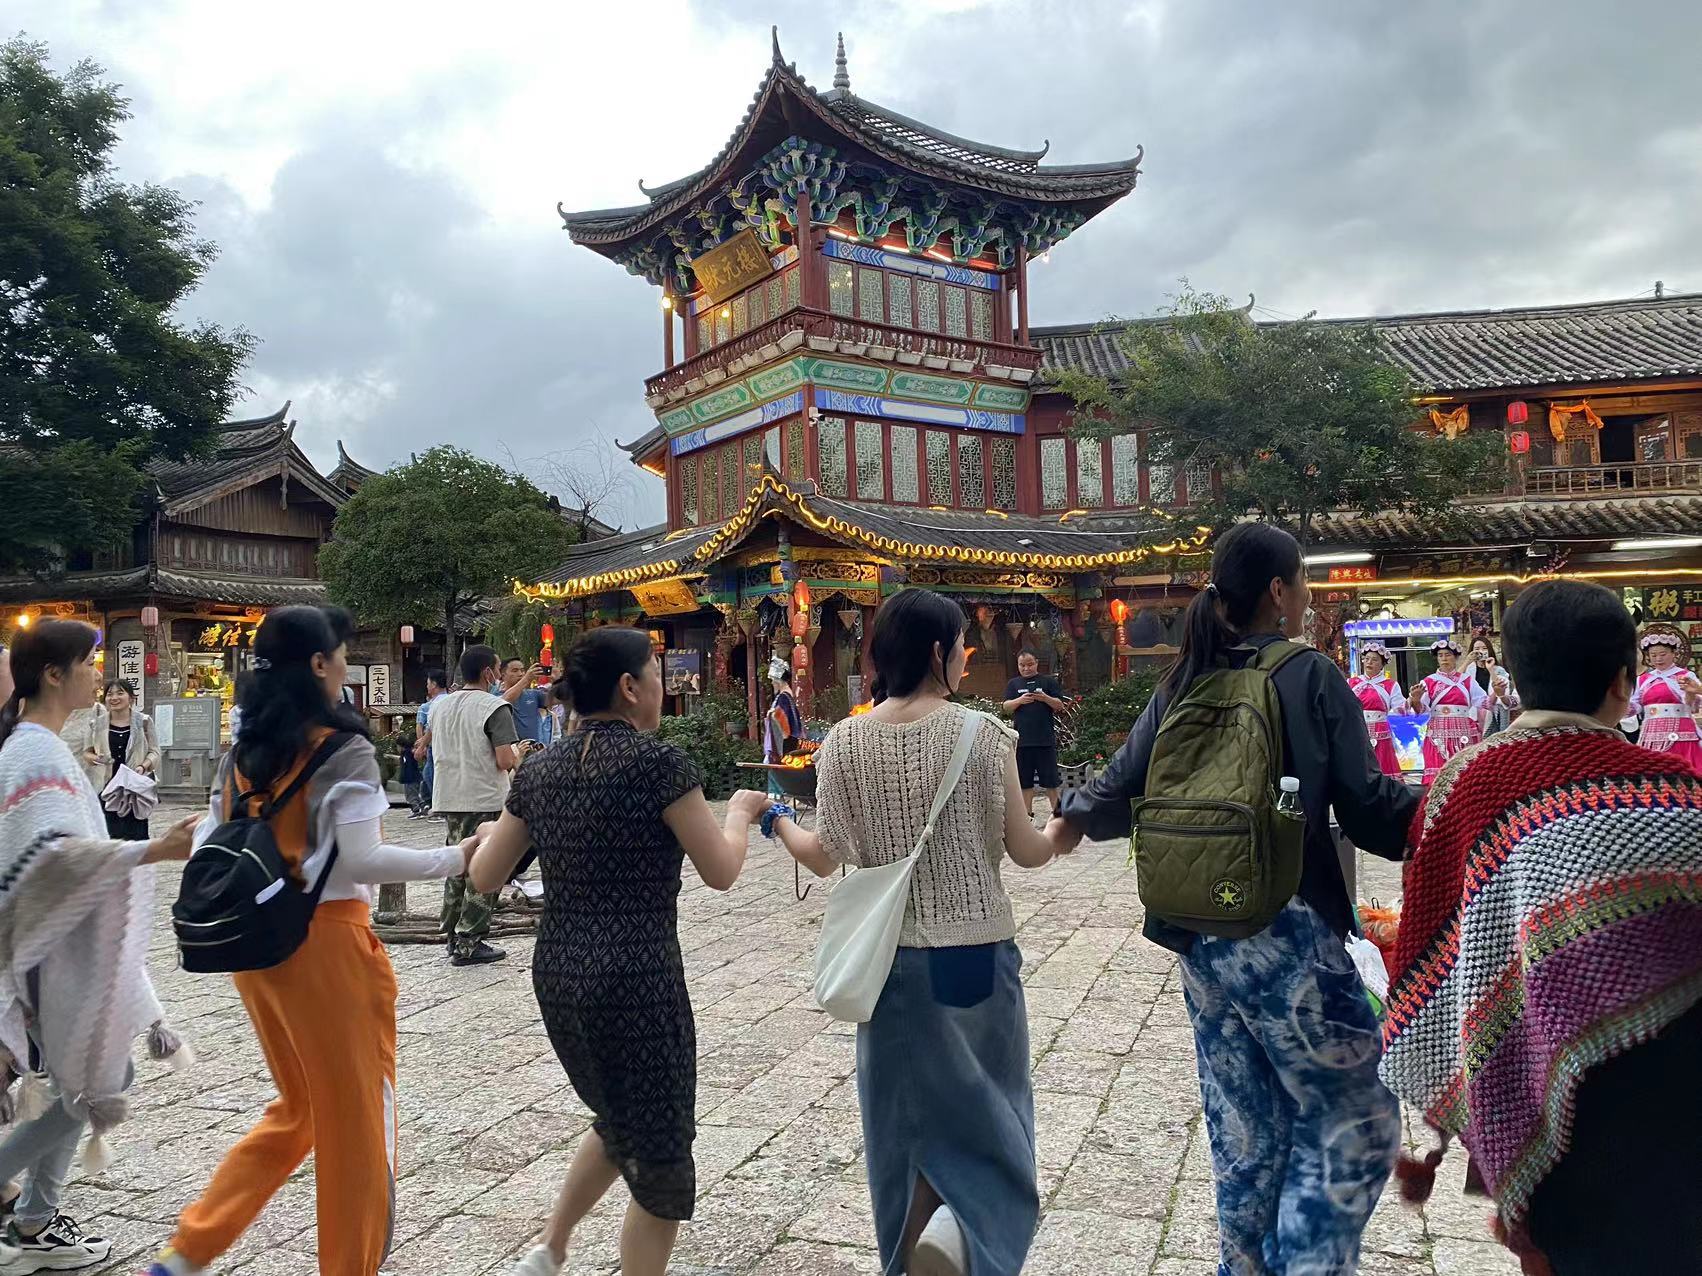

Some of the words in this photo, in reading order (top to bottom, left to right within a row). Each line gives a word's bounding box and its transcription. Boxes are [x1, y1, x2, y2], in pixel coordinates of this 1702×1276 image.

[1647, 588, 1680, 617] 粥
[1682, 589, 1702, 604] 手工
[121, 645, 141, 708] 游佳超
[372, 667, 386, 705] 三七天麻
